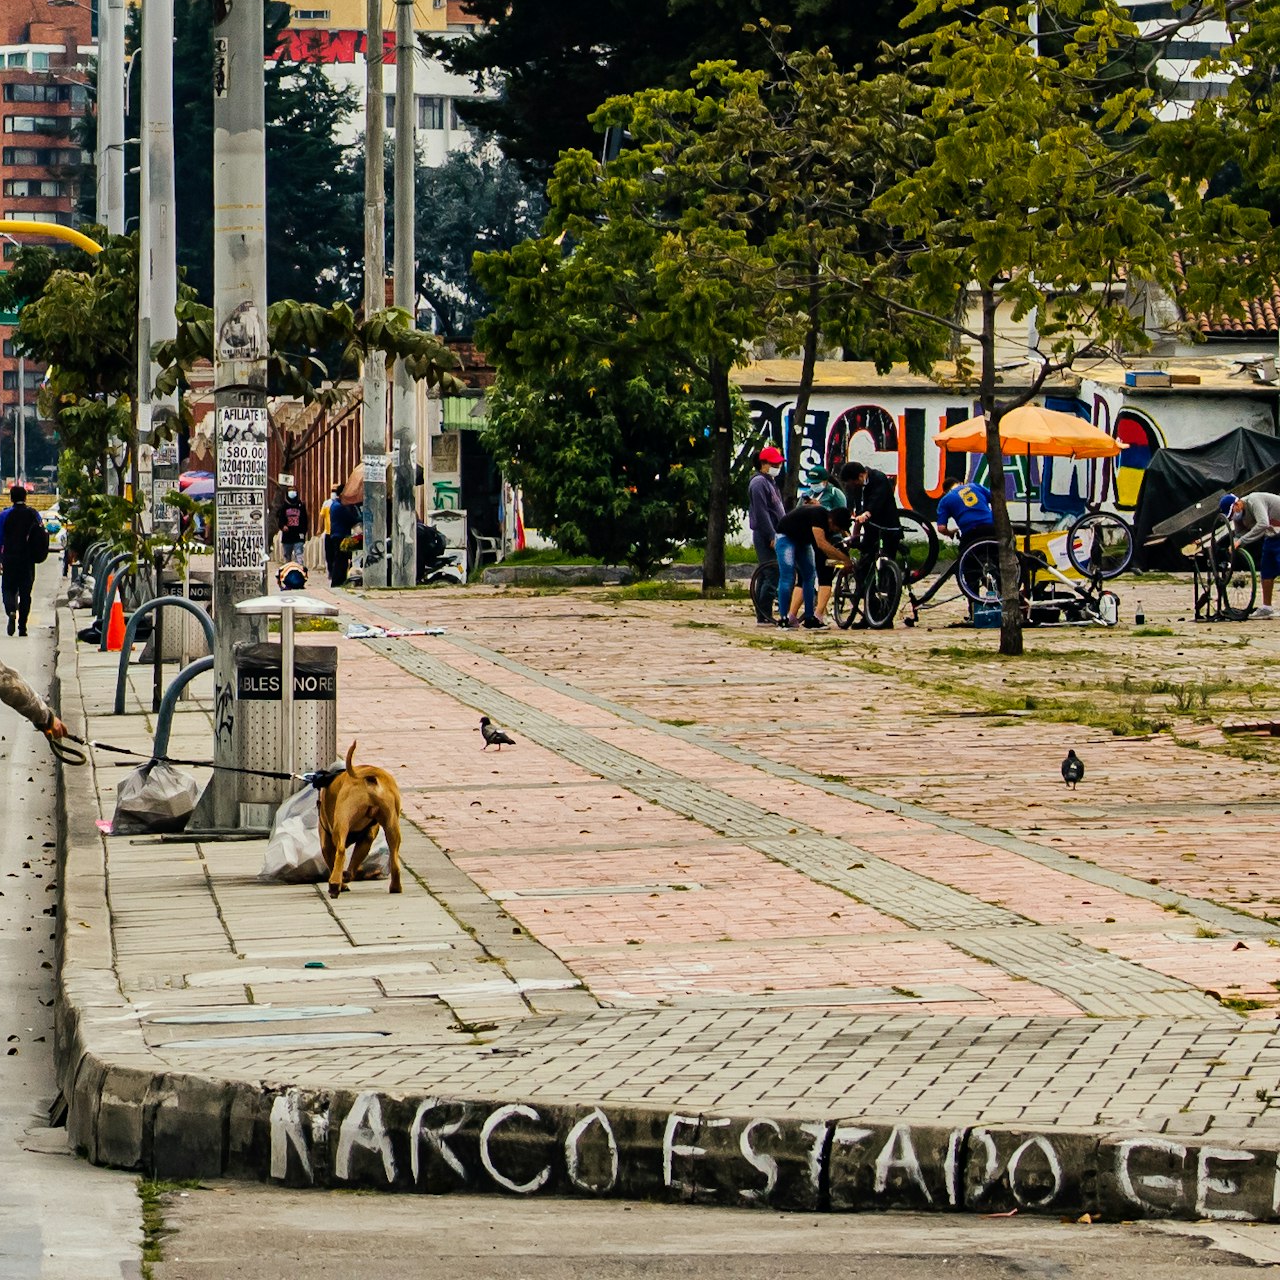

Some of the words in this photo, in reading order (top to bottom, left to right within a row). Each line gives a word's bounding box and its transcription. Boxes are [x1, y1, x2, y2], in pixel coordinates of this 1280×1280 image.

[224, 410, 259, 421] AFILIATE
[958, 487, 978, 507] 6
[269, 1087, 619, 1194] NARCO
[662, 1112, 1062, 1207] ESTADO
